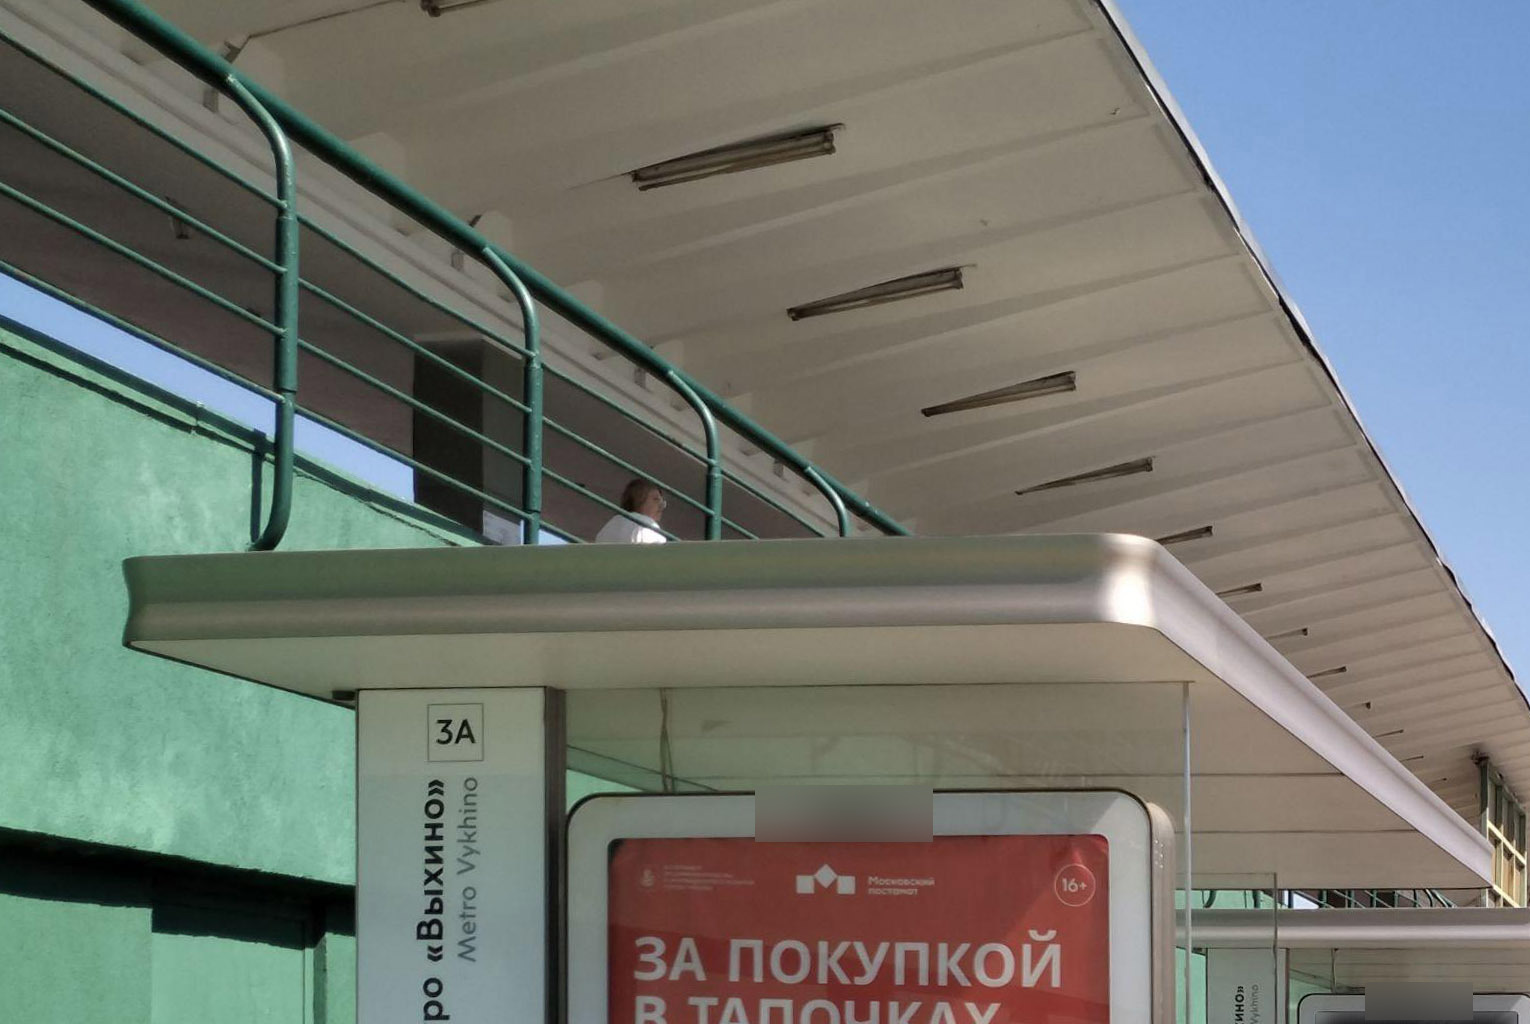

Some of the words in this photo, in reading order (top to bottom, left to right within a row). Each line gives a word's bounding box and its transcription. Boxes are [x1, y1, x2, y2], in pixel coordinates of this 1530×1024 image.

[457, 776, 482, 877] Vykhino
[416, 778, 446, 963] «Выхино»
[1061, 877, 1088, 893] 16+
[457, 886, 478, 963] Metro
[634, 935, 708, 983] ЗА
[728, 928, 1063, 989] ПОКУПКОЙ
